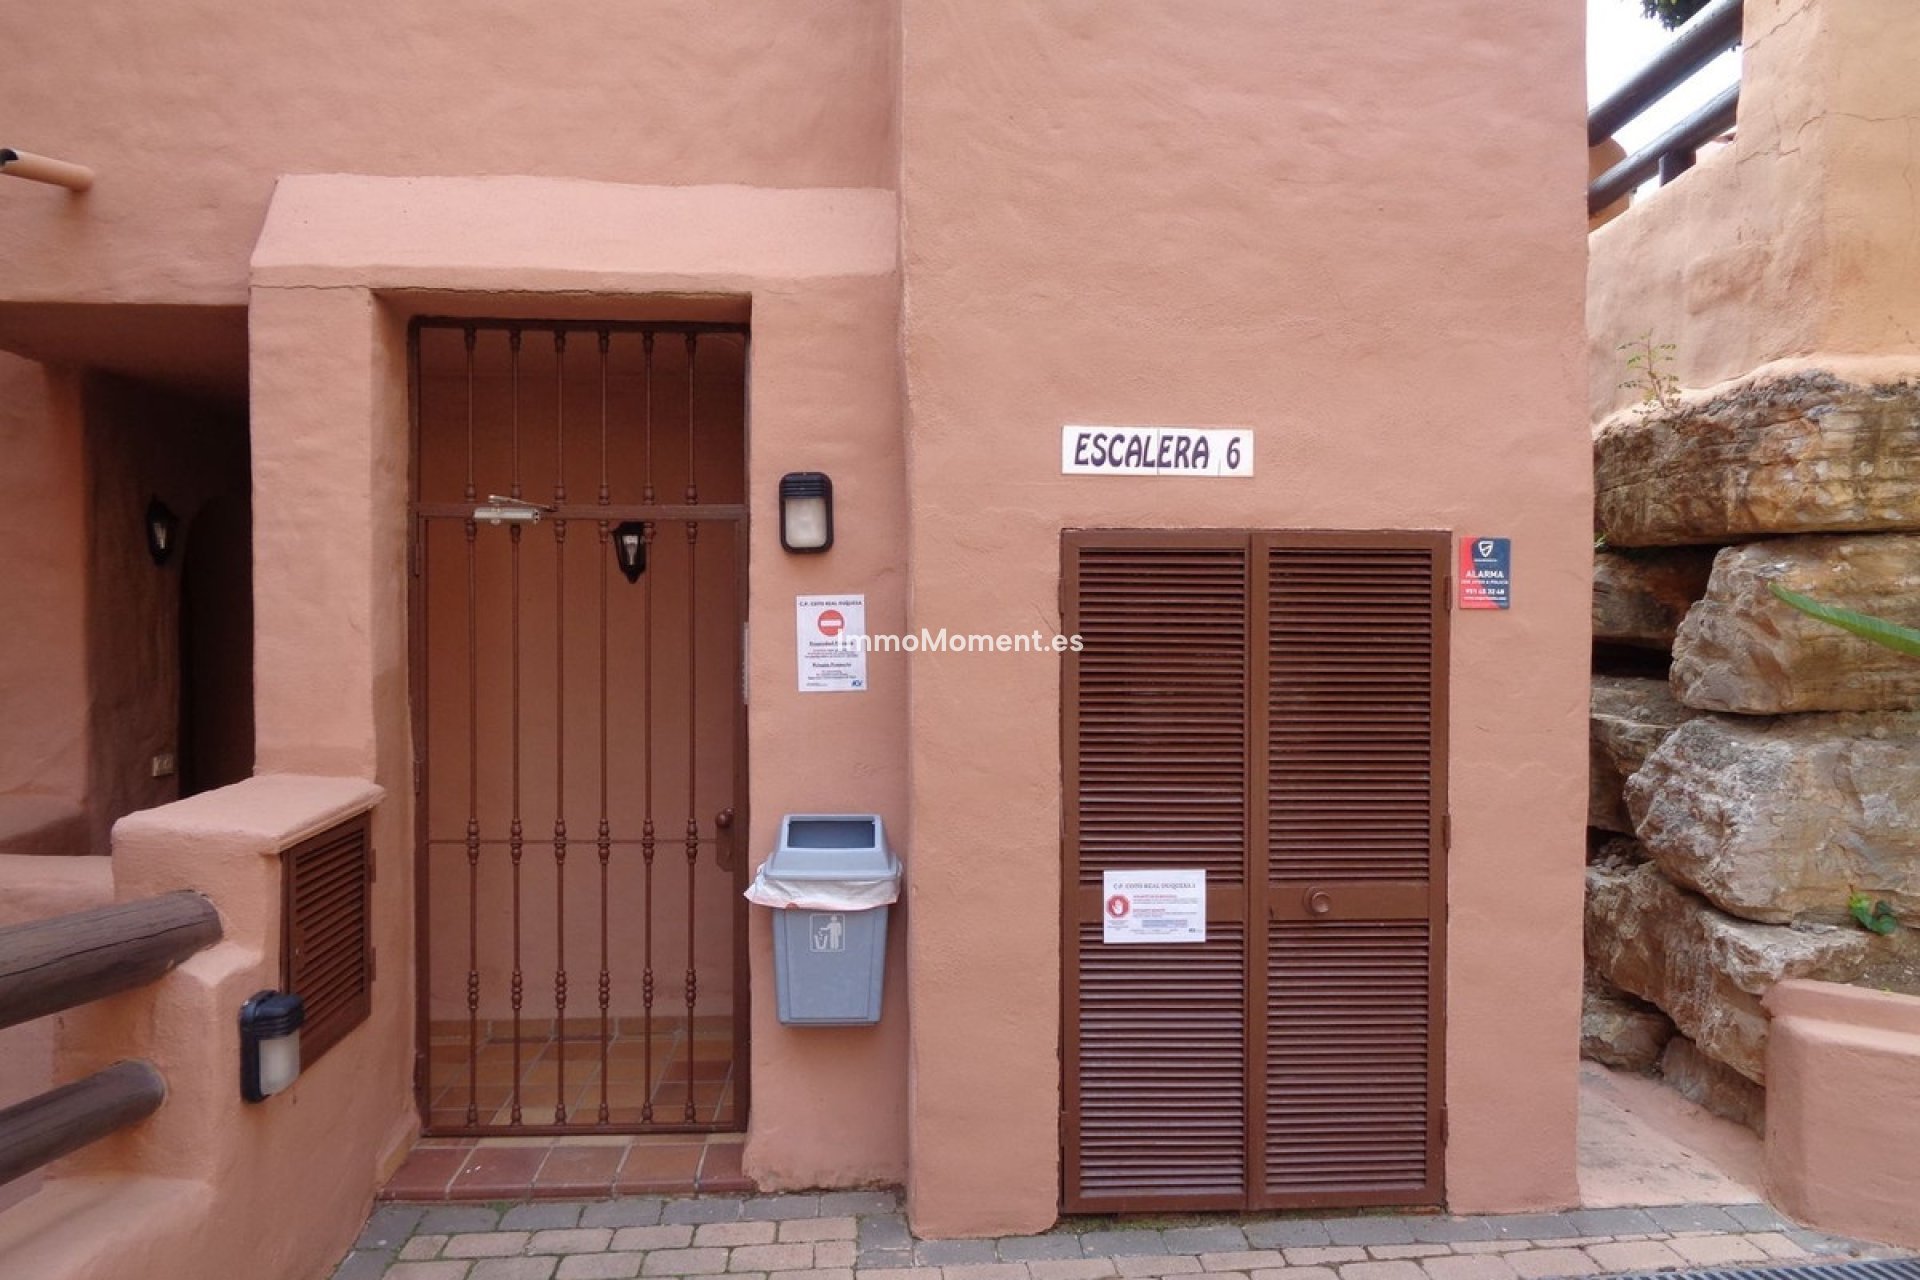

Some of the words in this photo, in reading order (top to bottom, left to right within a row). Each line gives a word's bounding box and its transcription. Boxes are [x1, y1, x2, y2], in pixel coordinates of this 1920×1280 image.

[1074, 432, 1209, 469] ESCALERA
[1226, 436, 1241, 470] 6
[1465, 570, 1505, 578] ALARMA
